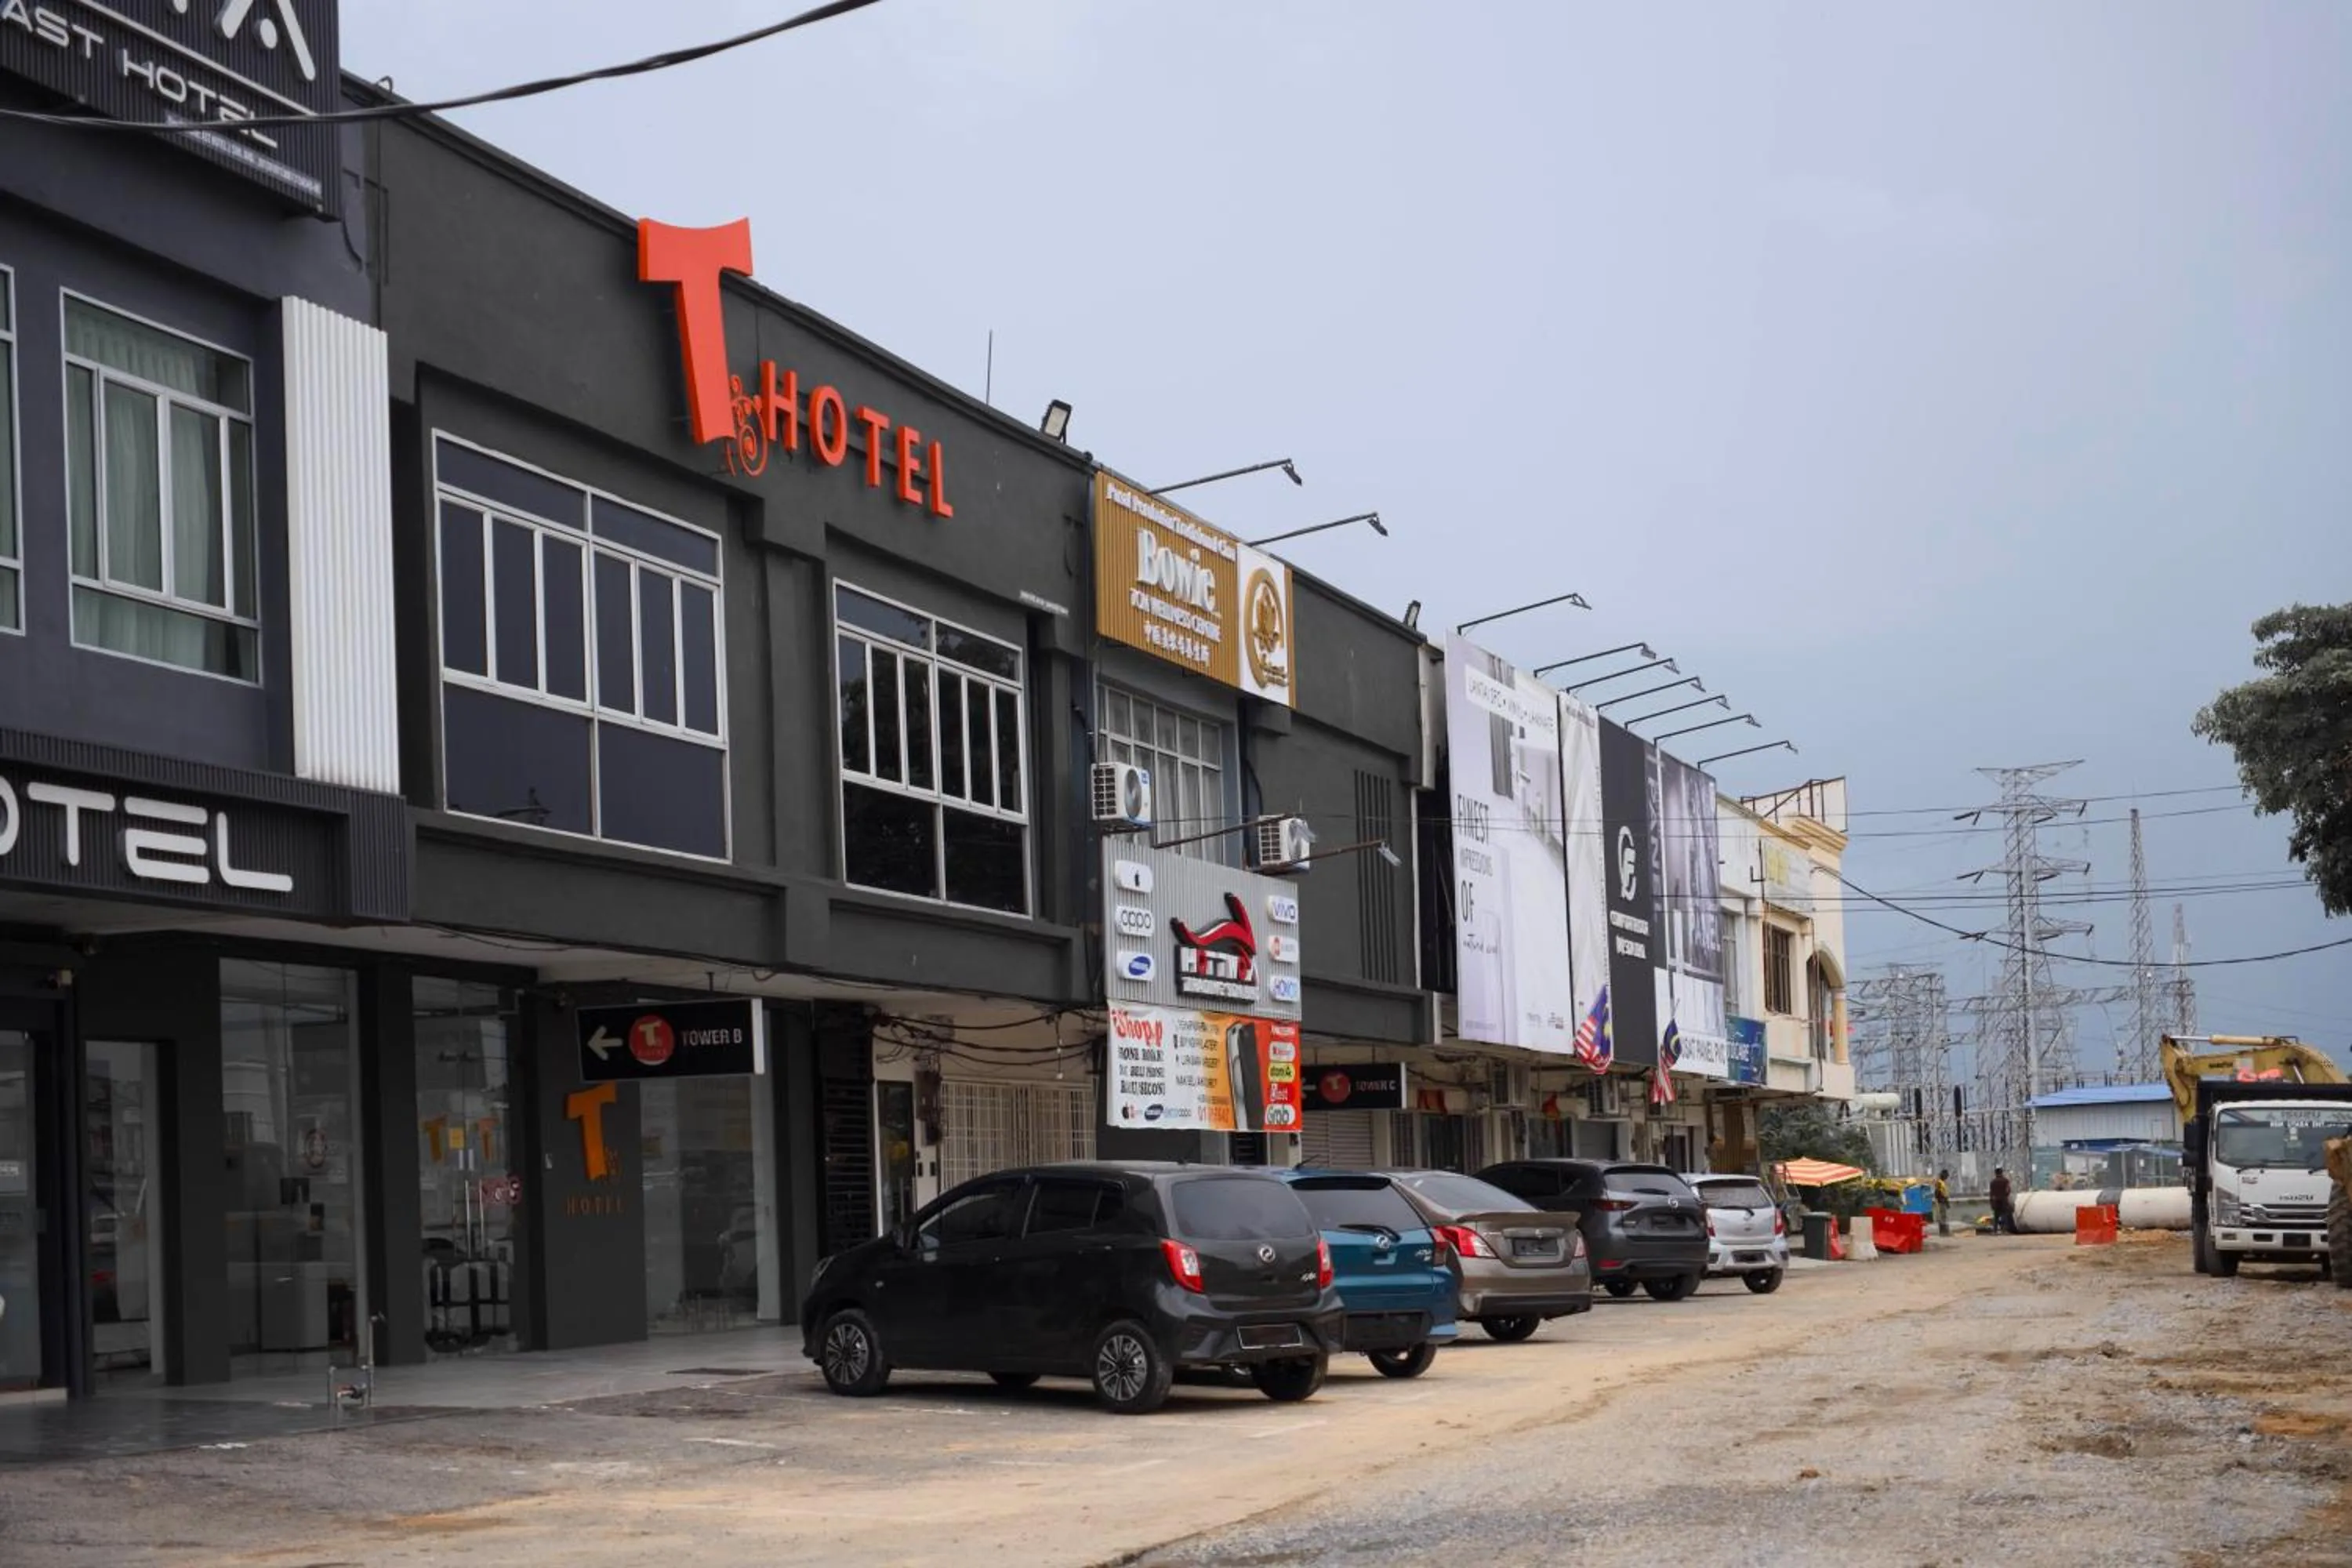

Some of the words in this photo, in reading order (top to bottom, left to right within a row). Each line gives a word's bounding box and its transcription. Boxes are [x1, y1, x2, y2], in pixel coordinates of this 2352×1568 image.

[122, 48, 278, 149] HOTEL
[760, 360, 953, 518] HOTEL
[1457, 793, 1490, 846] FINEST
[1461, 879, 1475, 924] OF
[680, 1030, 730, 1047] TOWER
[733, 1027, 743, 1044] B
